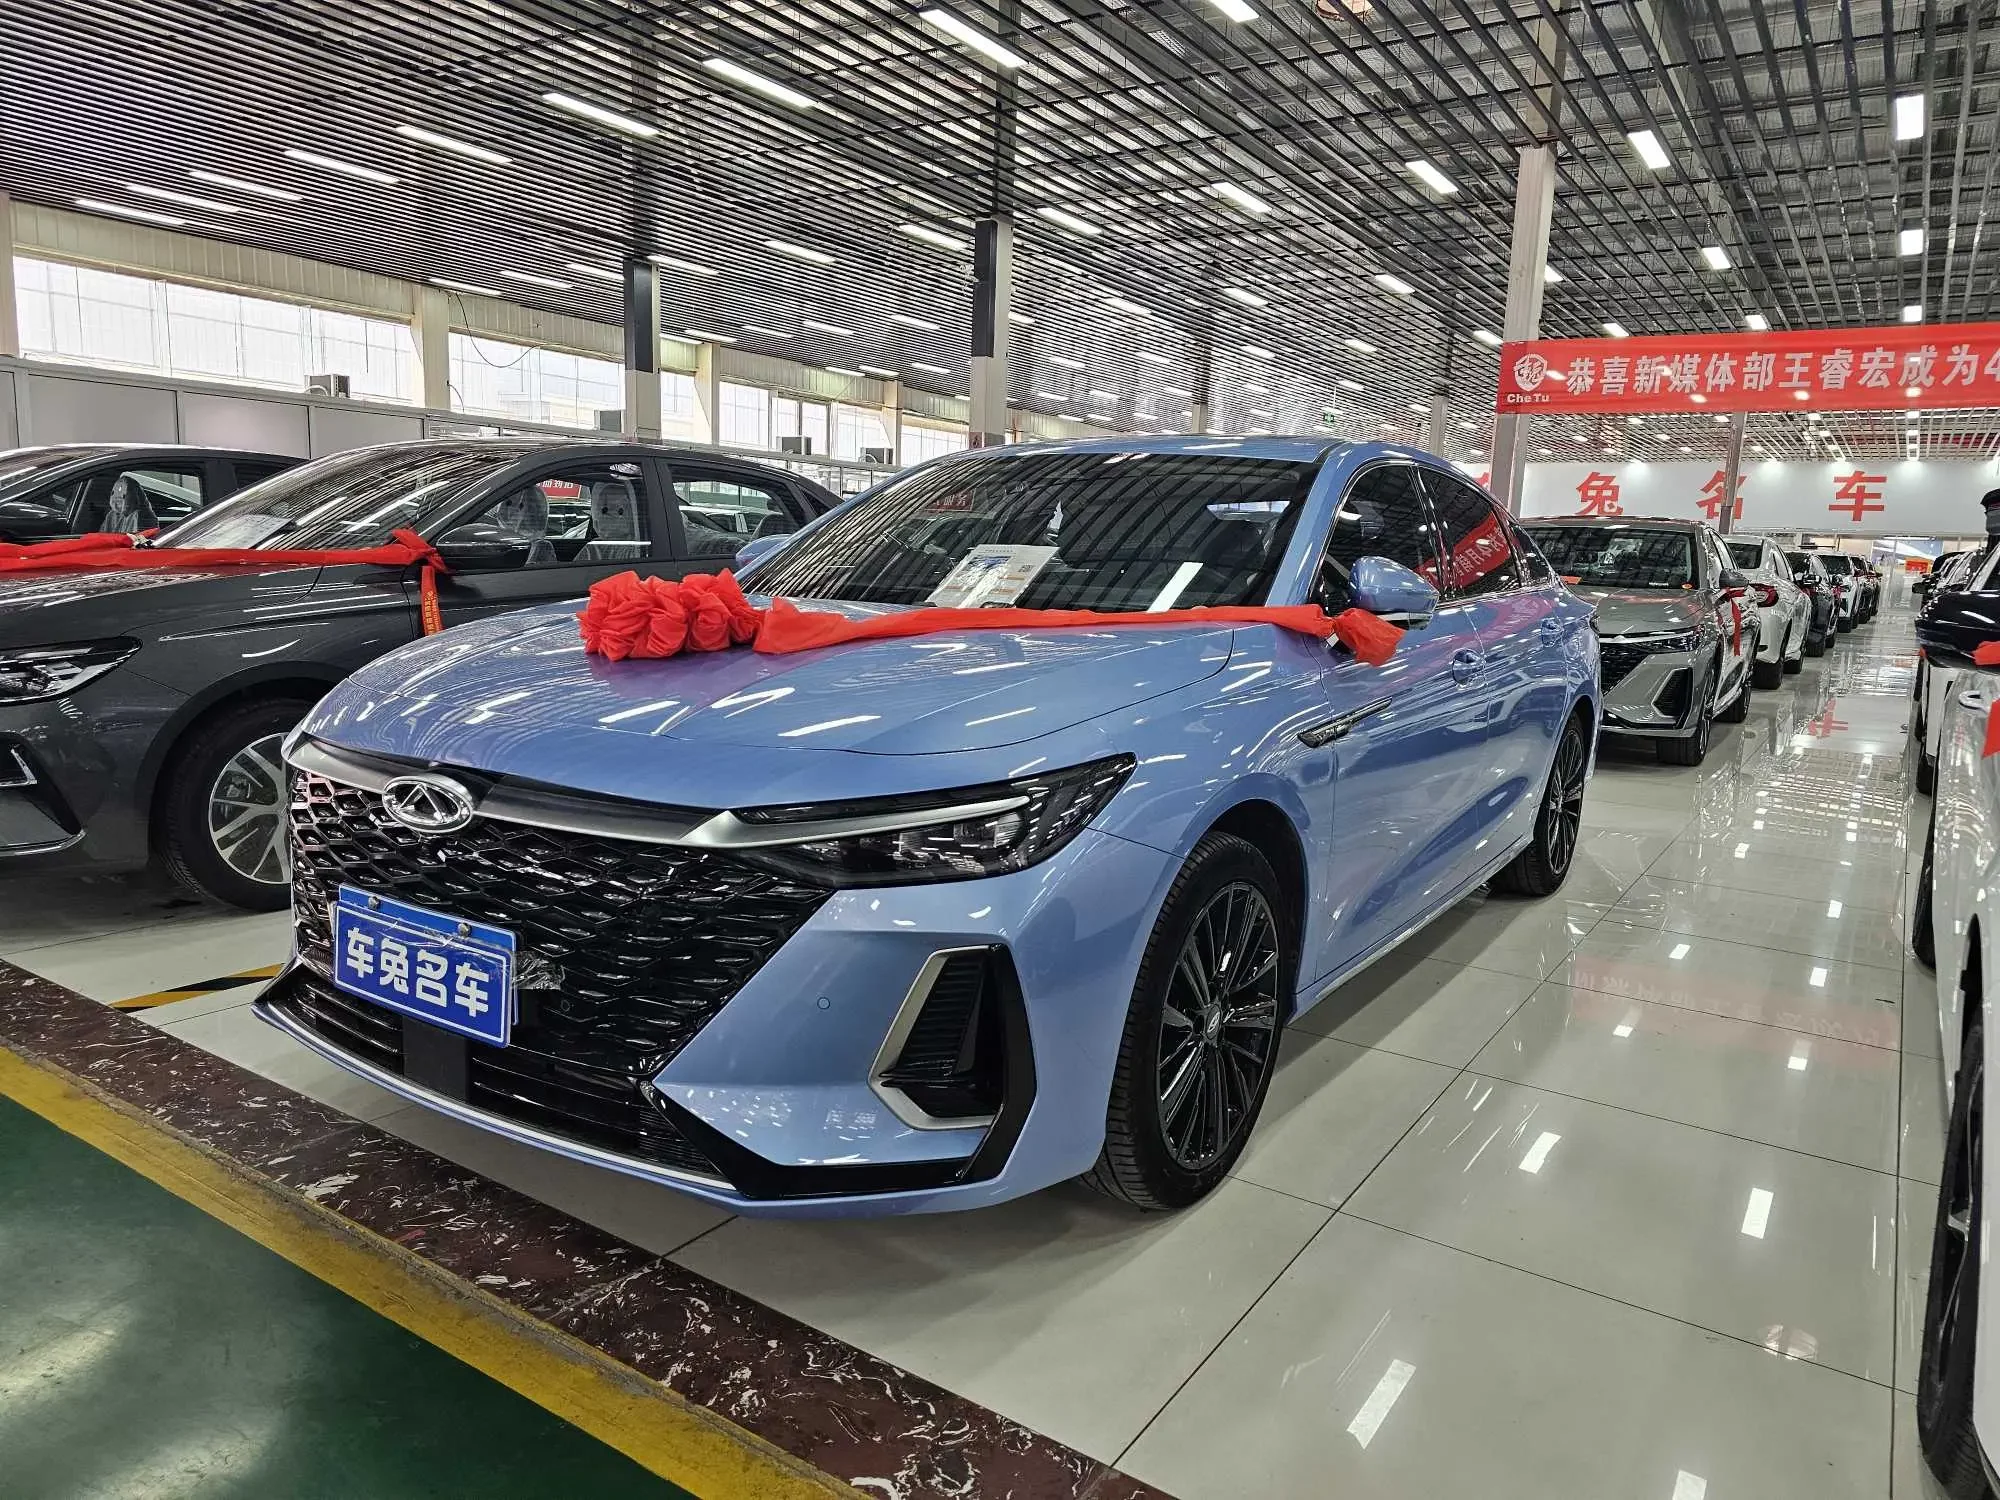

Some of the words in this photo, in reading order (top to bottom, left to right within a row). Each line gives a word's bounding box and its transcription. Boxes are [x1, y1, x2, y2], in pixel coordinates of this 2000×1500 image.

[1567, 344, 2000, 395] 恭喜新媒体部王睿宏成为4
[1506, 393, 1532, 403] Che
[346, 927, 490, 1018] 车兔名车
